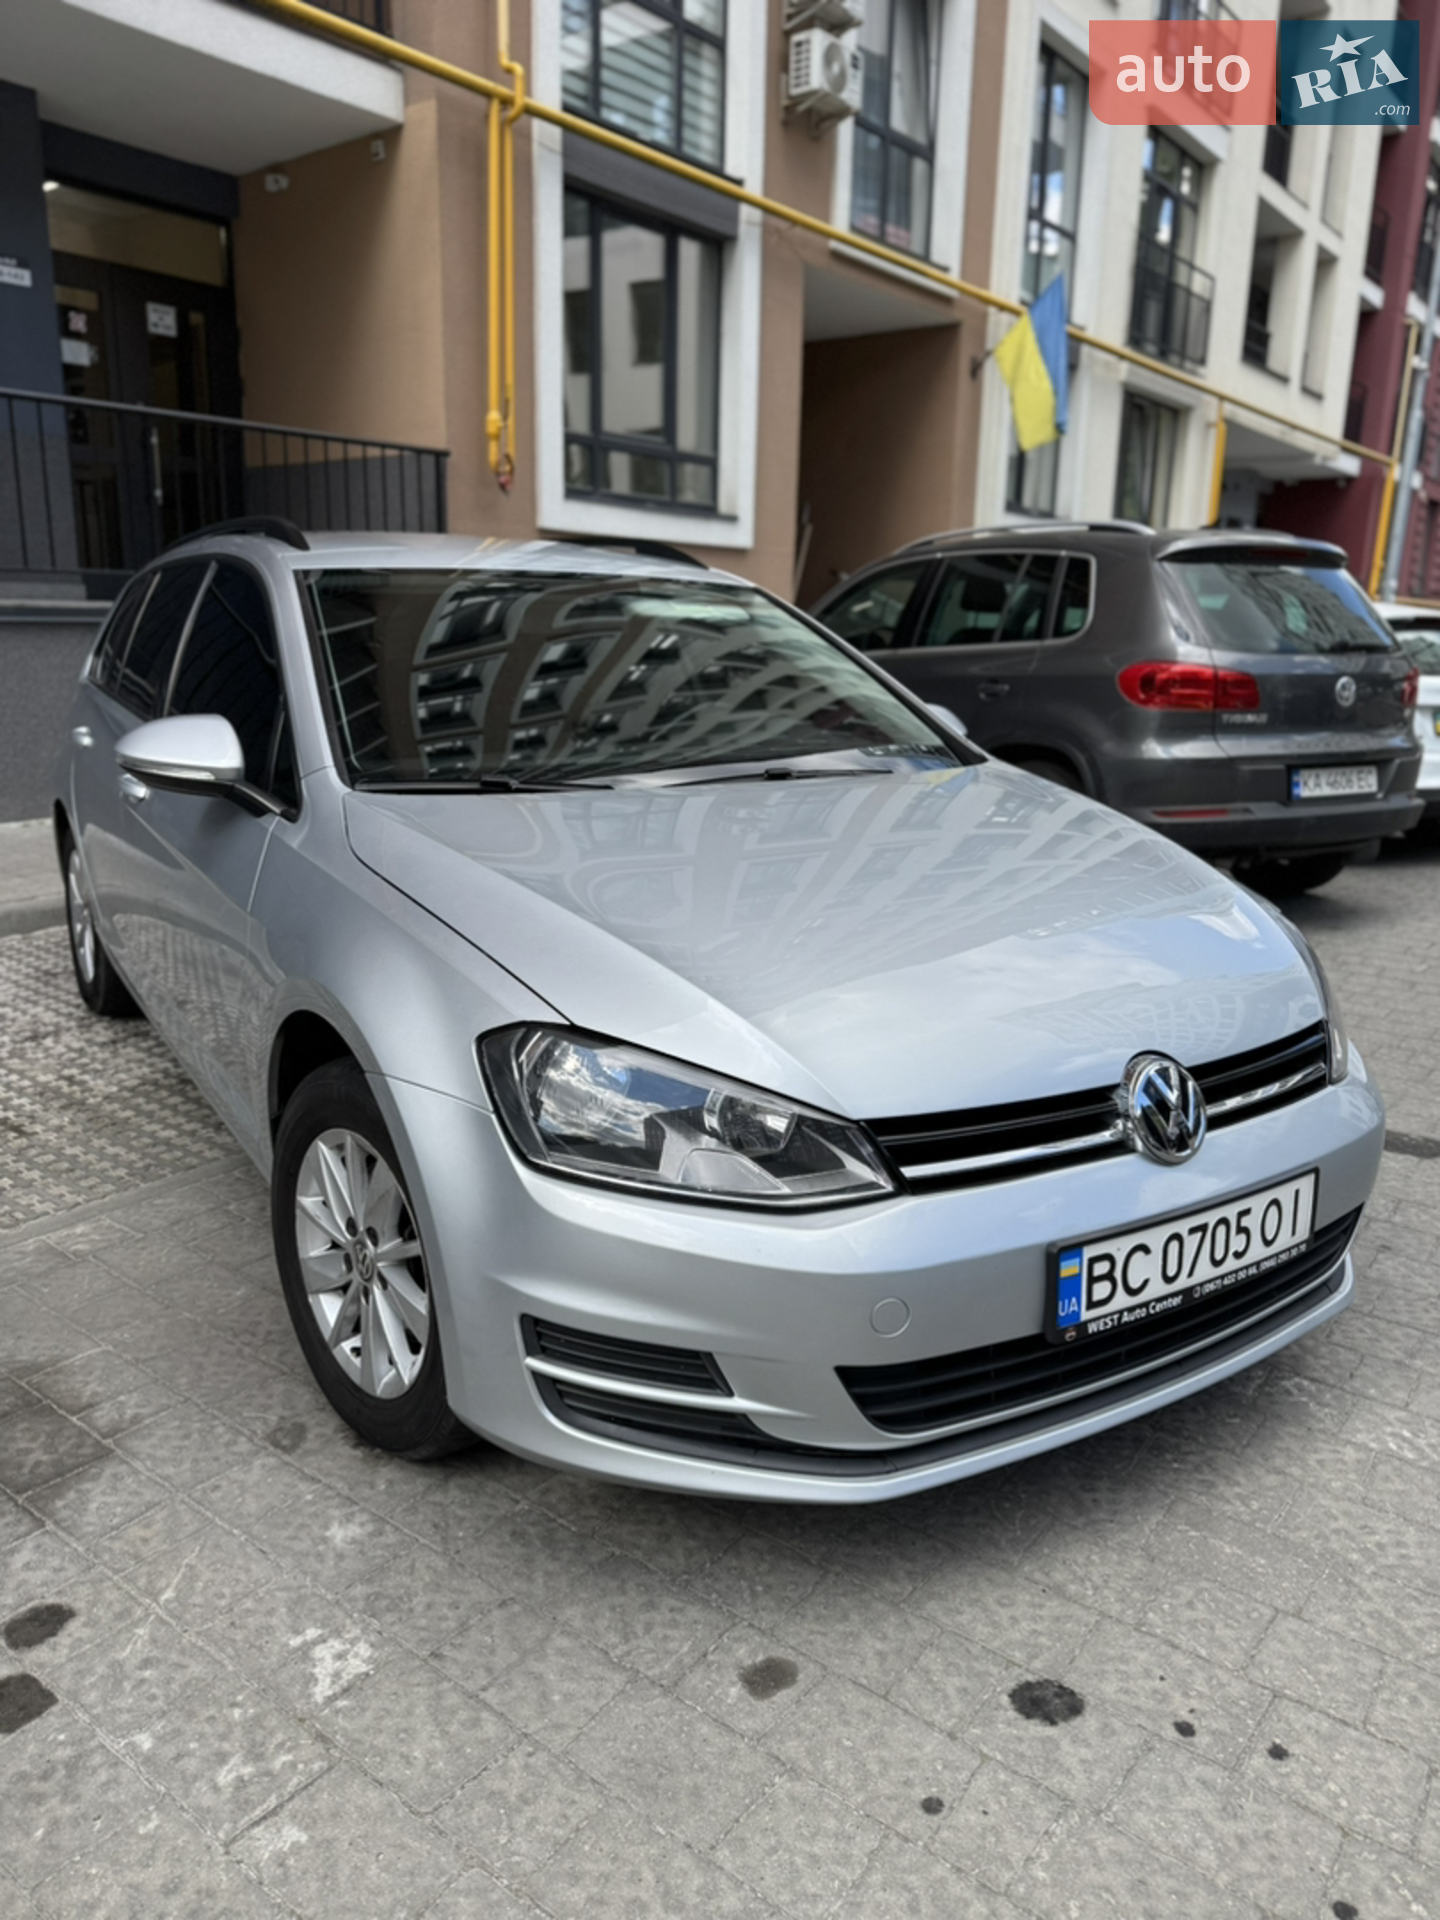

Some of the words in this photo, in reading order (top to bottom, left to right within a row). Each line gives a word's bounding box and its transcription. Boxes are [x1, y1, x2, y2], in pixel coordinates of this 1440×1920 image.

[1085, 1242, 1152, 1311] BC
[1160, 1207, 1252, 1285] 0705
[1058, 1297, 1078, 1317] UA
[1087, 1313, 1120, 1334] WEST
[1121, 1307, 1147, 1323] Auto
[1148, 1294, 1183, 1314] Center
